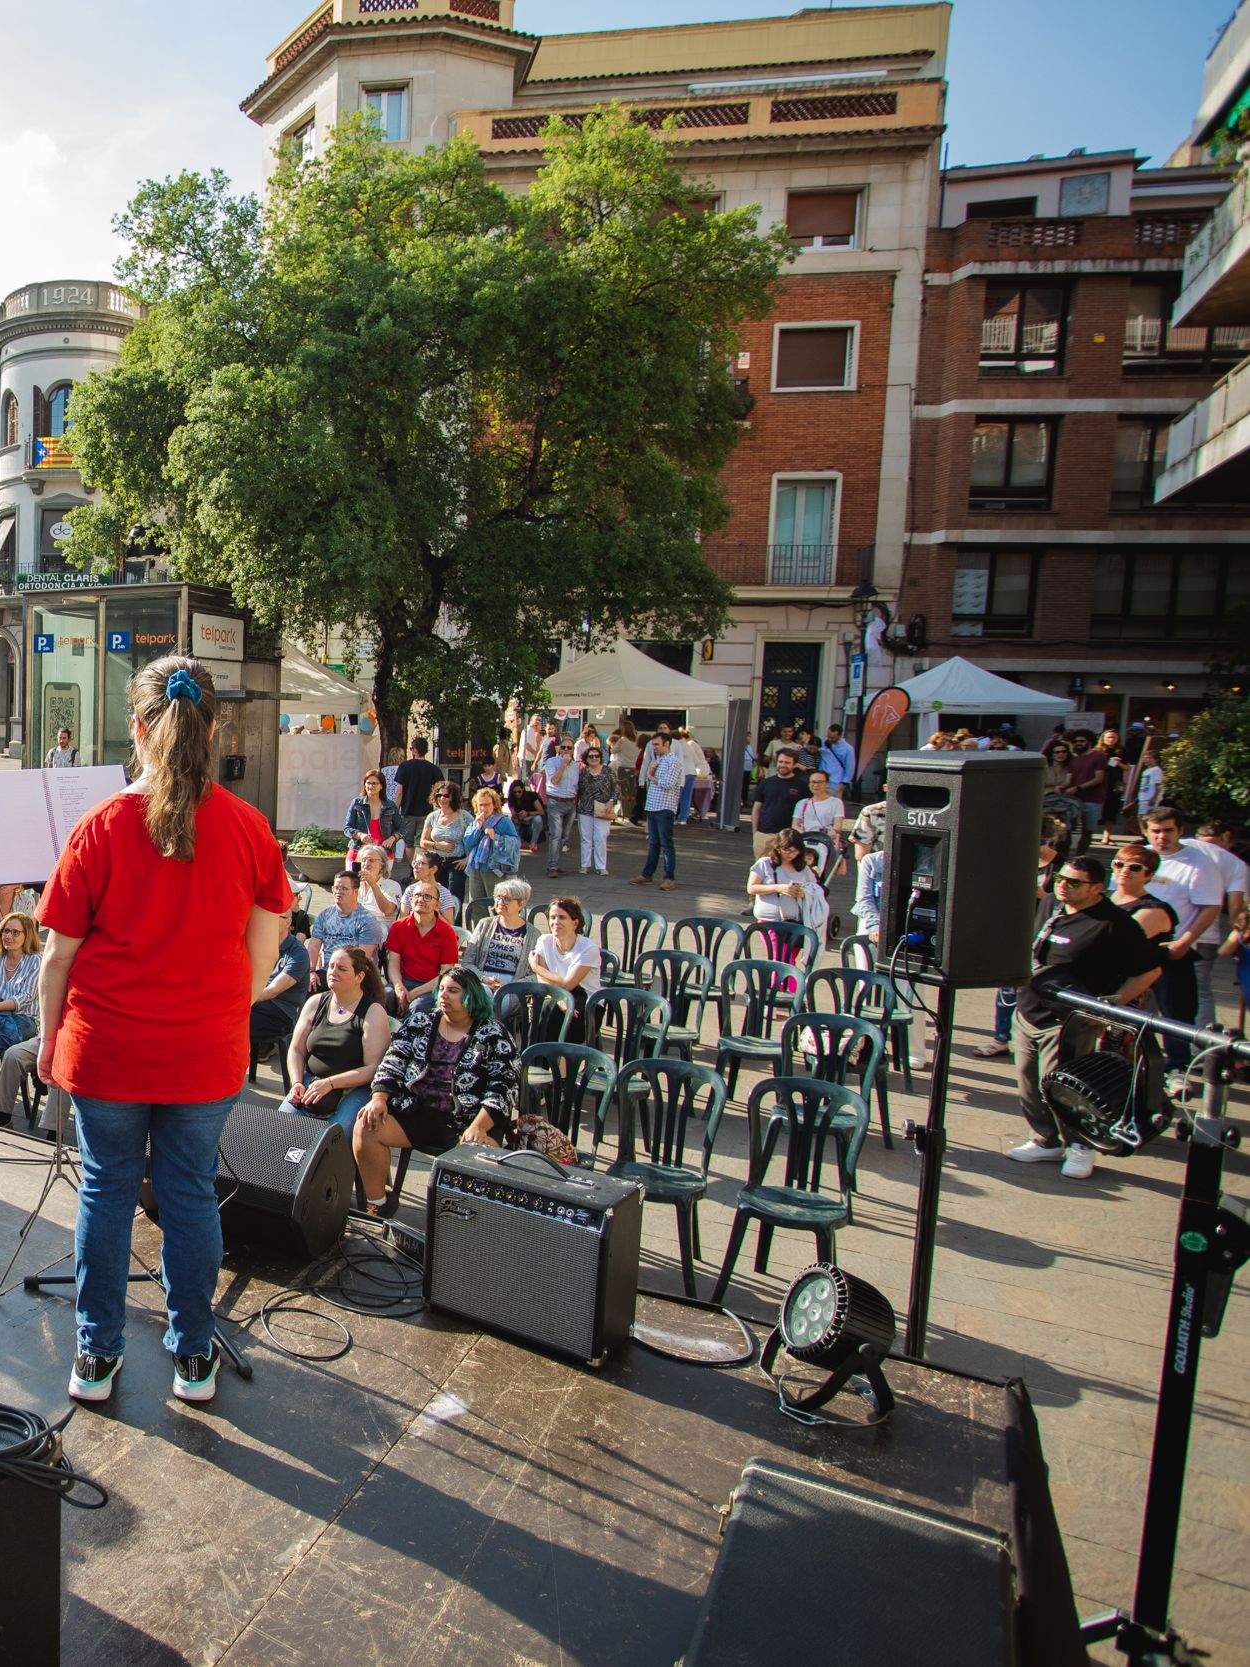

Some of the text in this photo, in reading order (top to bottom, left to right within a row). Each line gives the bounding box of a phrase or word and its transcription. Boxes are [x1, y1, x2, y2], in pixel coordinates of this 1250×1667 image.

[42, 286, 94, 306] 1924
[18, 582, 76, 590] ORTODONCIA
[27, 574, 62, 583] DENTAL
[57, 633, 95, 647] telpark
[134, 632, 176, 647] telpark
[200, 623, 237, 646] telpark
[906, 812, 938, 827] 504
[489, 941, 515, 953] OMES
[487, 958, 506, 969] OES
[488, 950, 521, 965] SHION
[1173, 1284, 1196, 1375] GOLIATH Studio
